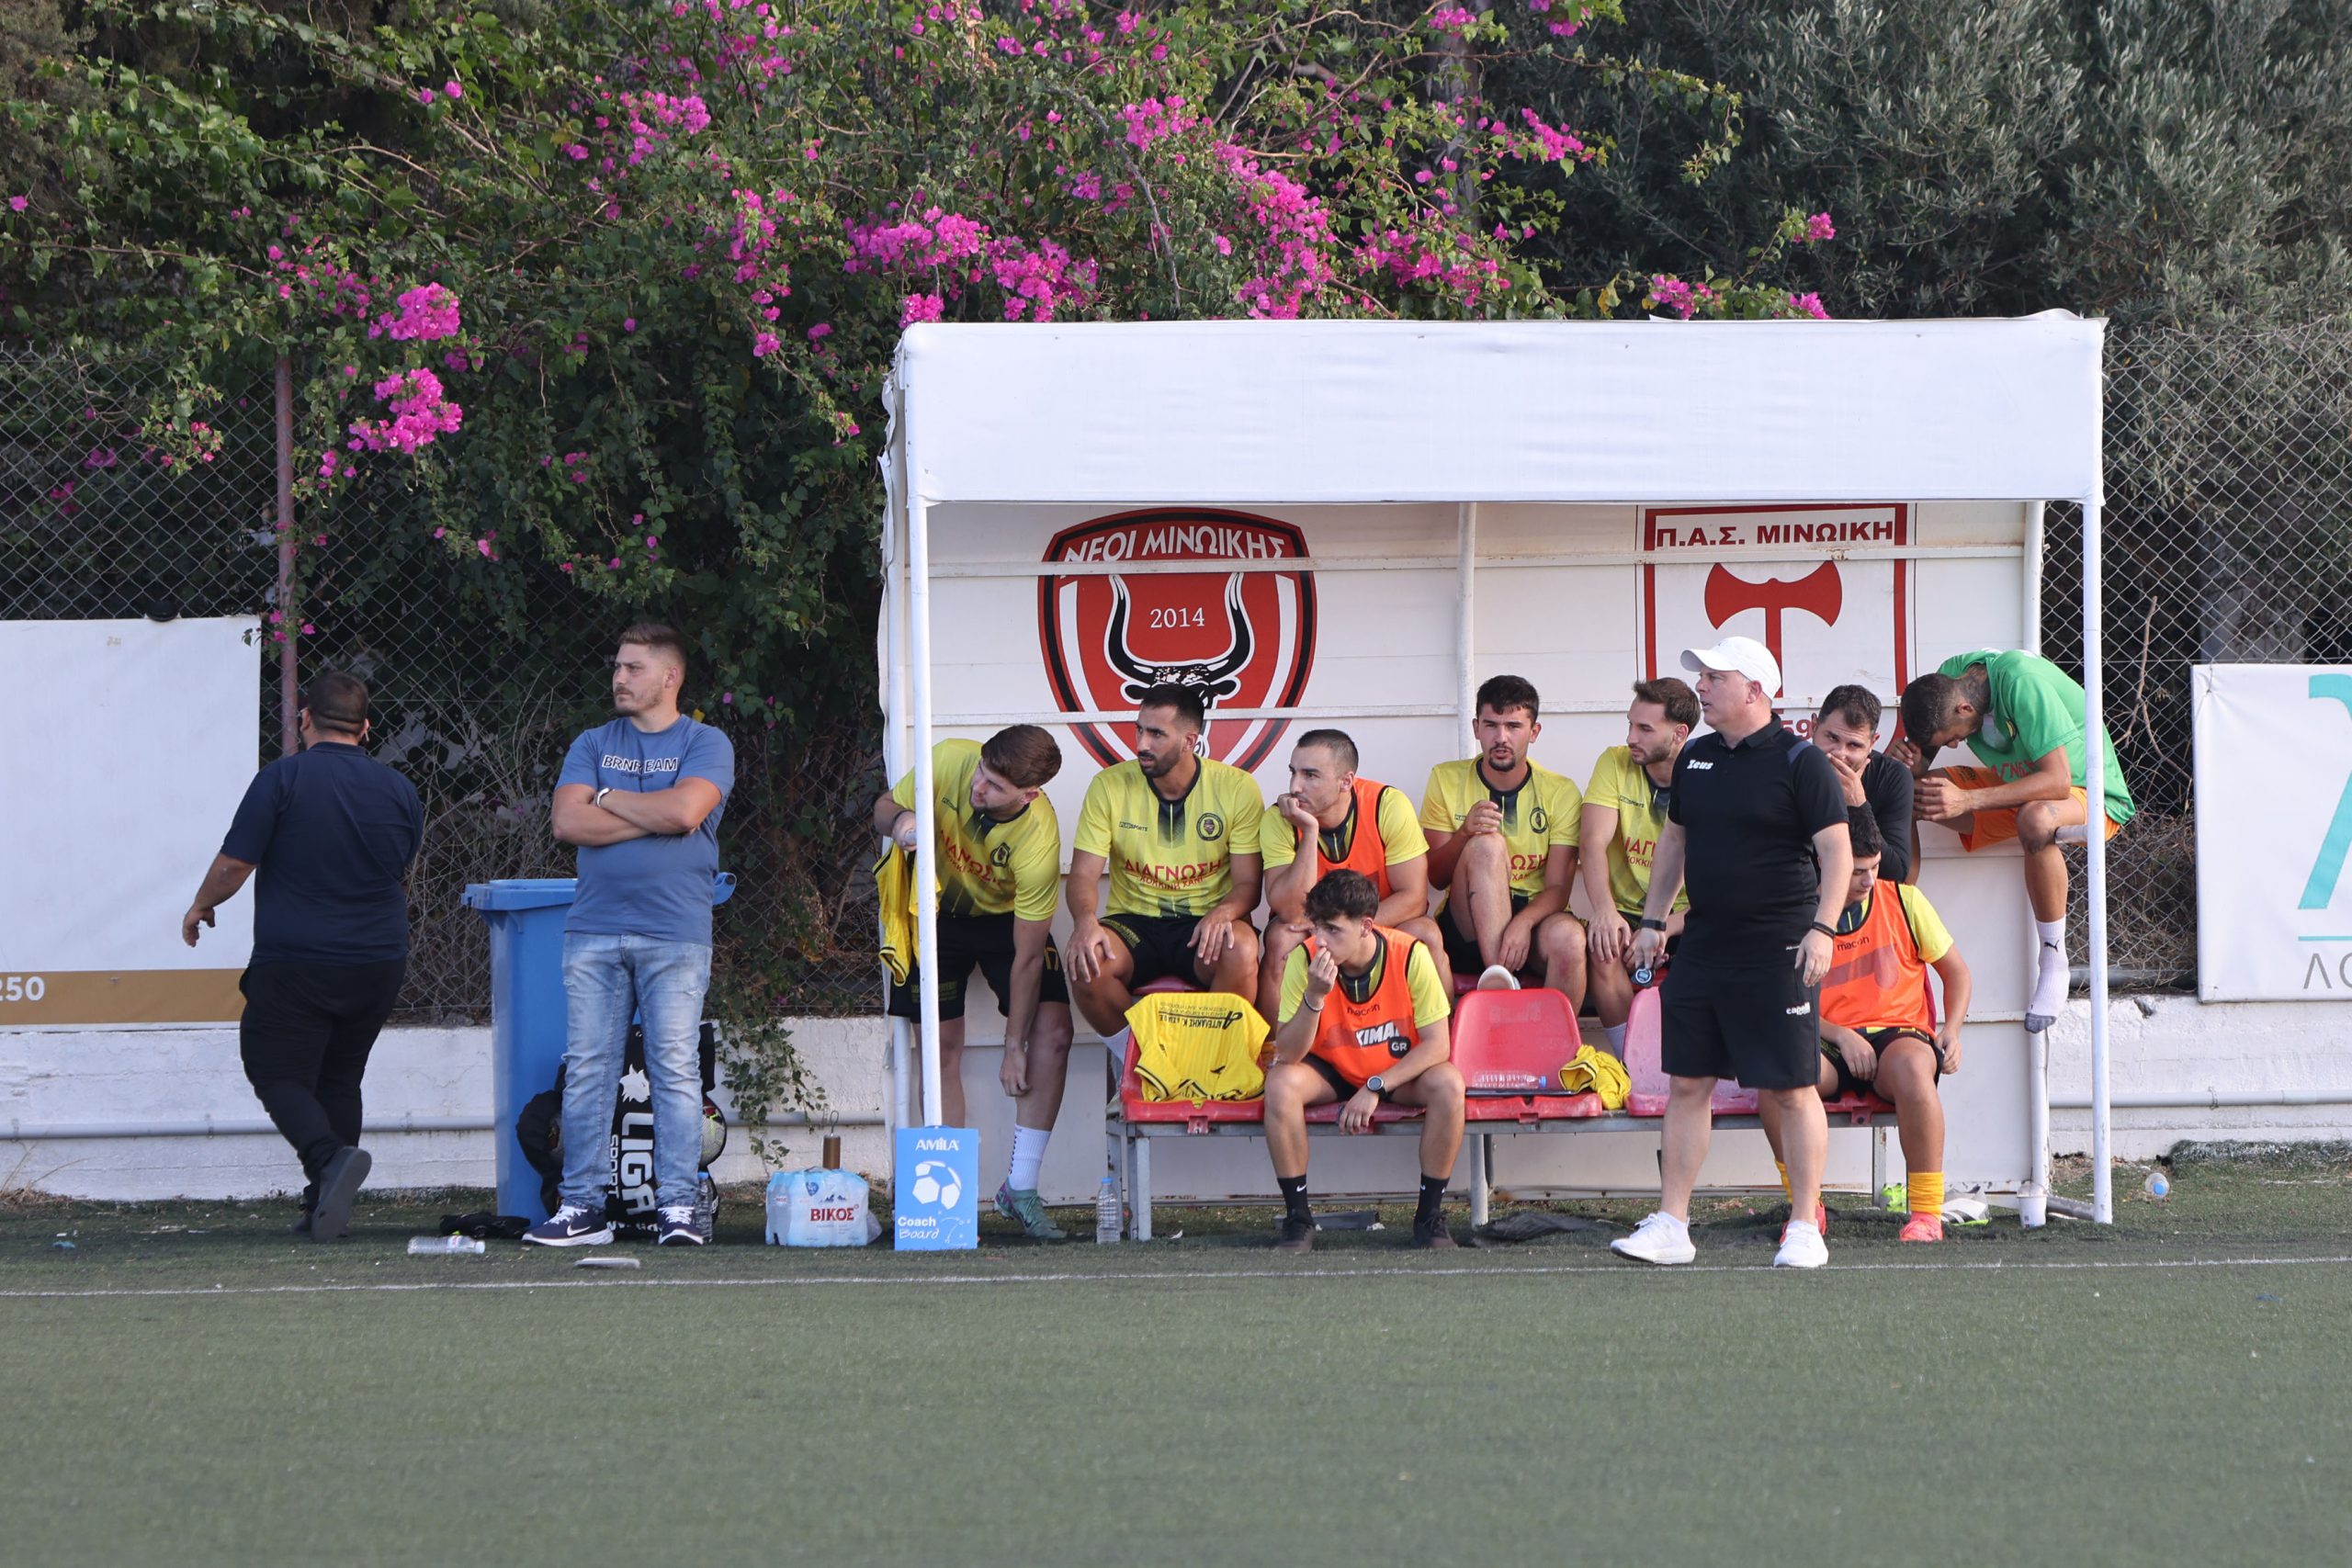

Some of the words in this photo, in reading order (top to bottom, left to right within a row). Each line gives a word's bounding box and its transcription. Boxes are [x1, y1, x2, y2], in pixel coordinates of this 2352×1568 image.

[1141, 525, 1285, 559] ΜΙΝΩΙΚΗΣ
[1657, 526, 1746, 547] Π.Α.Σ.
[1757, 521, 1894, 545] ΜΙΝΩΙΚΗ
[1150, 607, 1205, 628] 2014
[1687, 759, 1713, 770] Zeus
[0, 976, 45, 1001] 50
[1391, 1042, 1408, 1051] GR
[621, 1111, 656, 1216] LIGA
[810, 1207, 854, 1222] ΒΙΚΟΣ
[898, 1215, 936, 1227] Coach
[899, 1228, 939, 1239] Board
